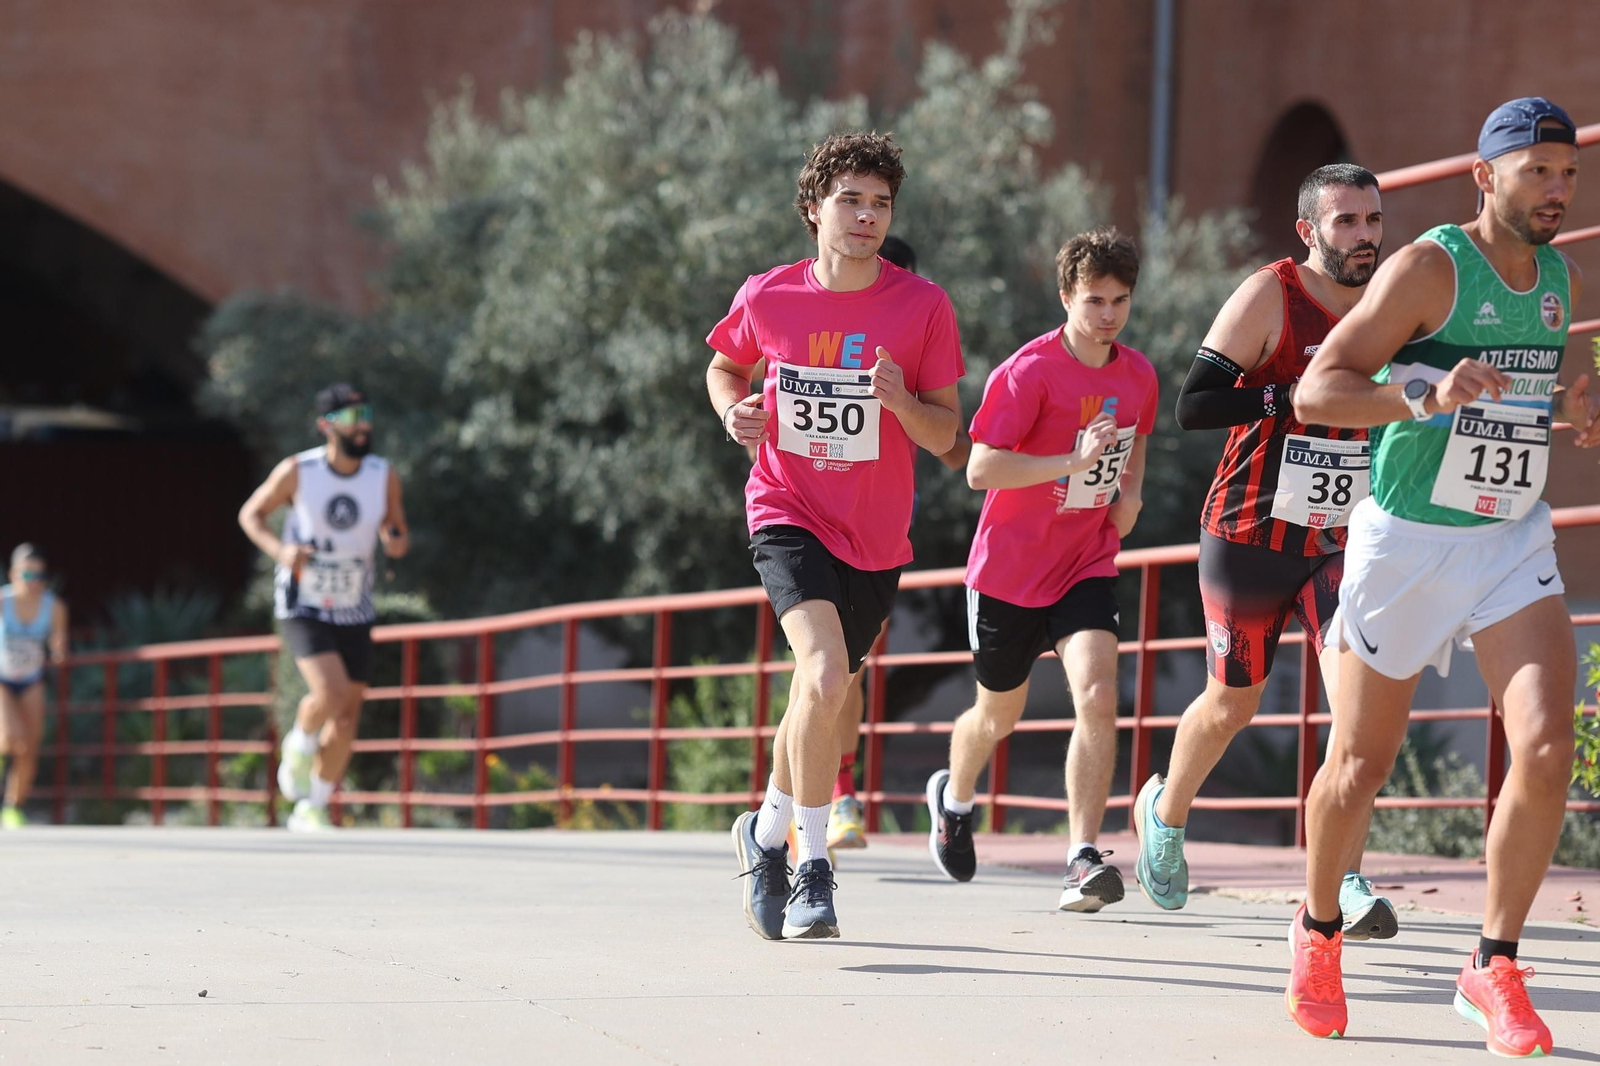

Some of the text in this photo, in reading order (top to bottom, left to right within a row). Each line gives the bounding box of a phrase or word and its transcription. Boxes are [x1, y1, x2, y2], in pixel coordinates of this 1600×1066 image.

[808, 331, 866, 368] WE
[1478, 349, 1558, 370] ATLETISMO
[782, 377, 825, 395] UMA
[793, 399, 864, 435] 350
[1460, 418, 1506, 439] UMA
[810, 445, 828, 454] WE
[1288, 450, 1333, 467] UMA
[1464, 444, 1532, 488] 131
[1307, 472, 1353, 506] 38
[1477, 499, 1496, 510] WE
[1309, 515, 1326, 525] WE
